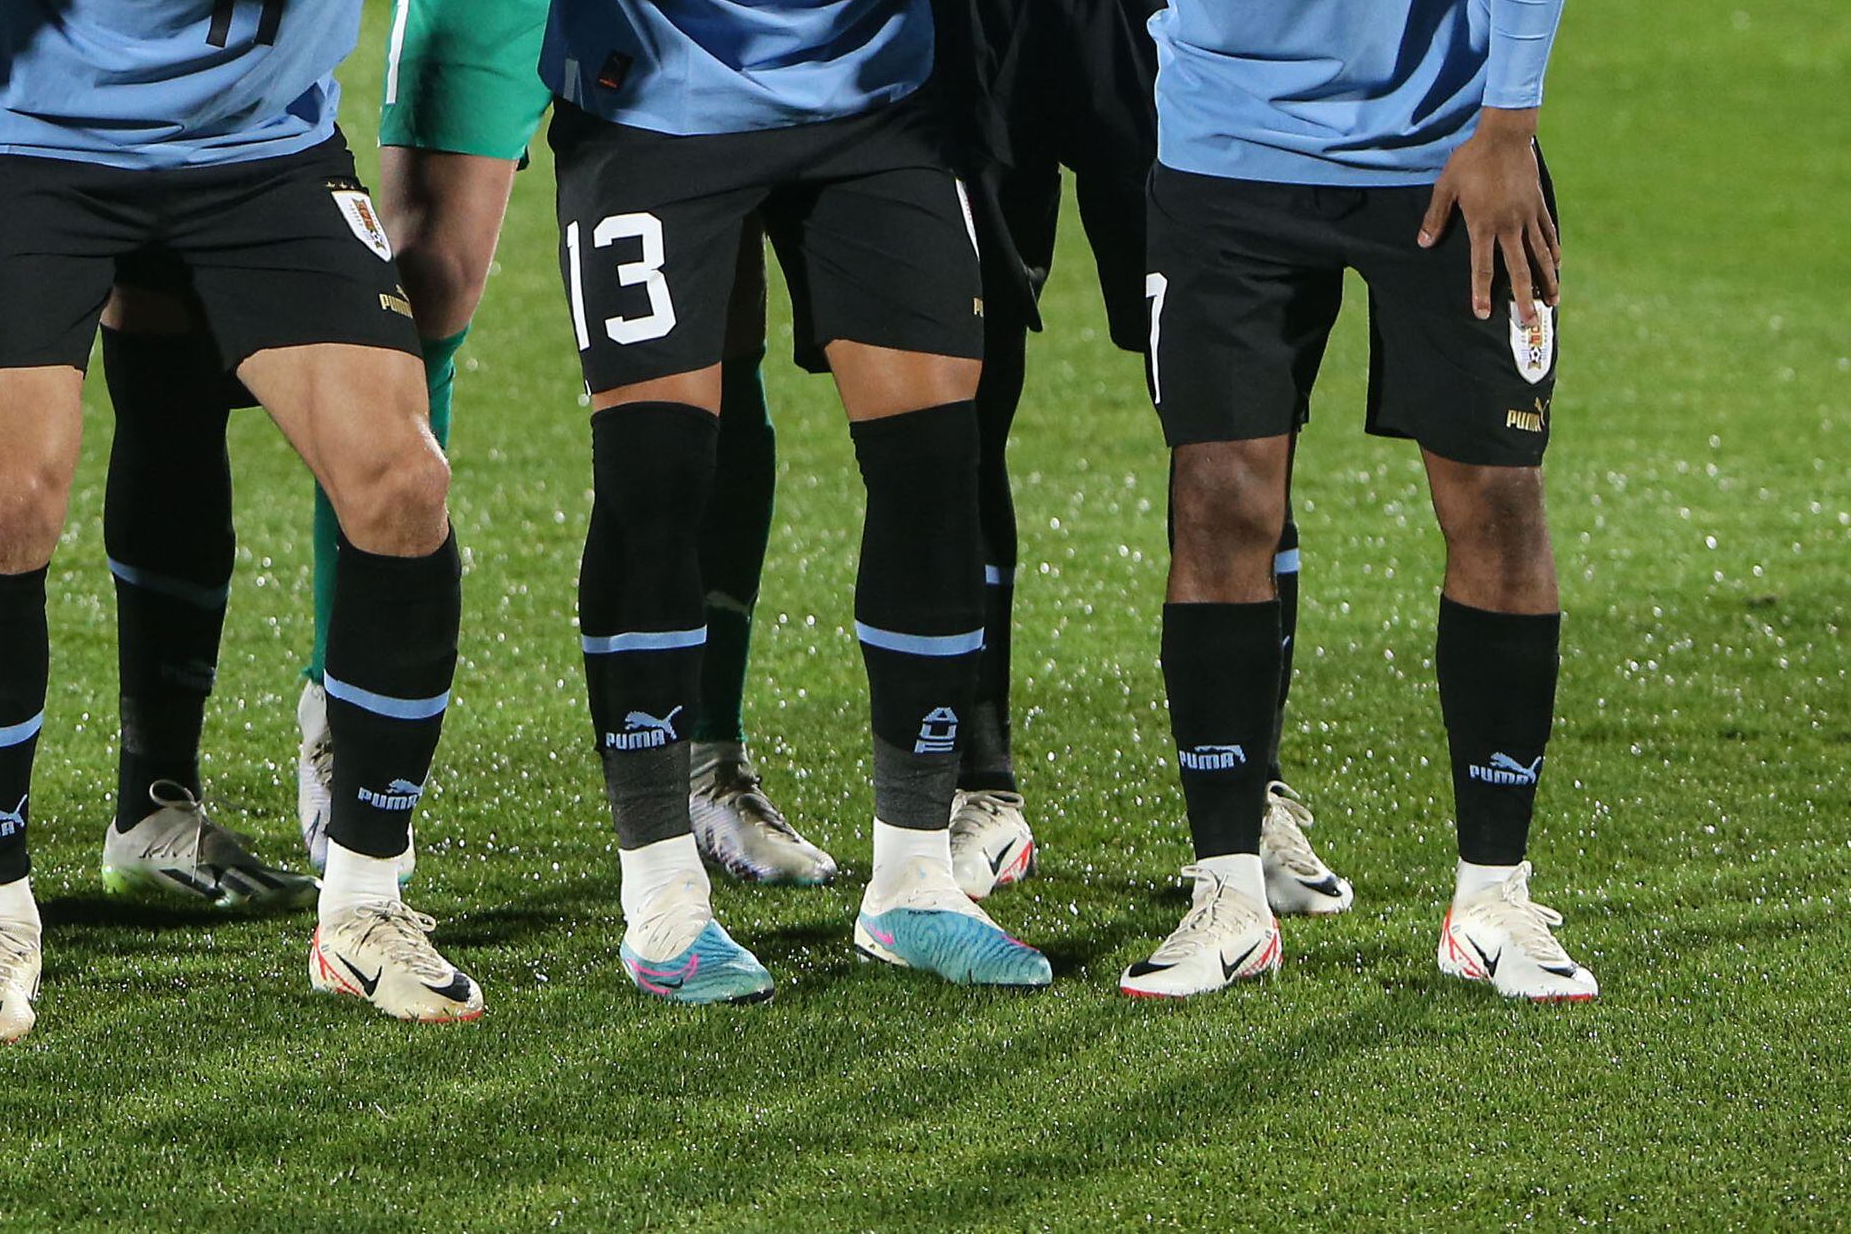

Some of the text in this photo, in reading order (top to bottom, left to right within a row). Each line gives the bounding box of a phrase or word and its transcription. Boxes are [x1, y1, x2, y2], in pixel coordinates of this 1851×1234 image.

[566, 212, 678, 351] 13
[605, 729, 667, 750] PUMA
[914, 707, 959, 754] AUF
[1179, 748, 1235, 771] PUMA
[1469, 764, 1529, 786] PUMA
[358, 787, 418, 811] PUMA
